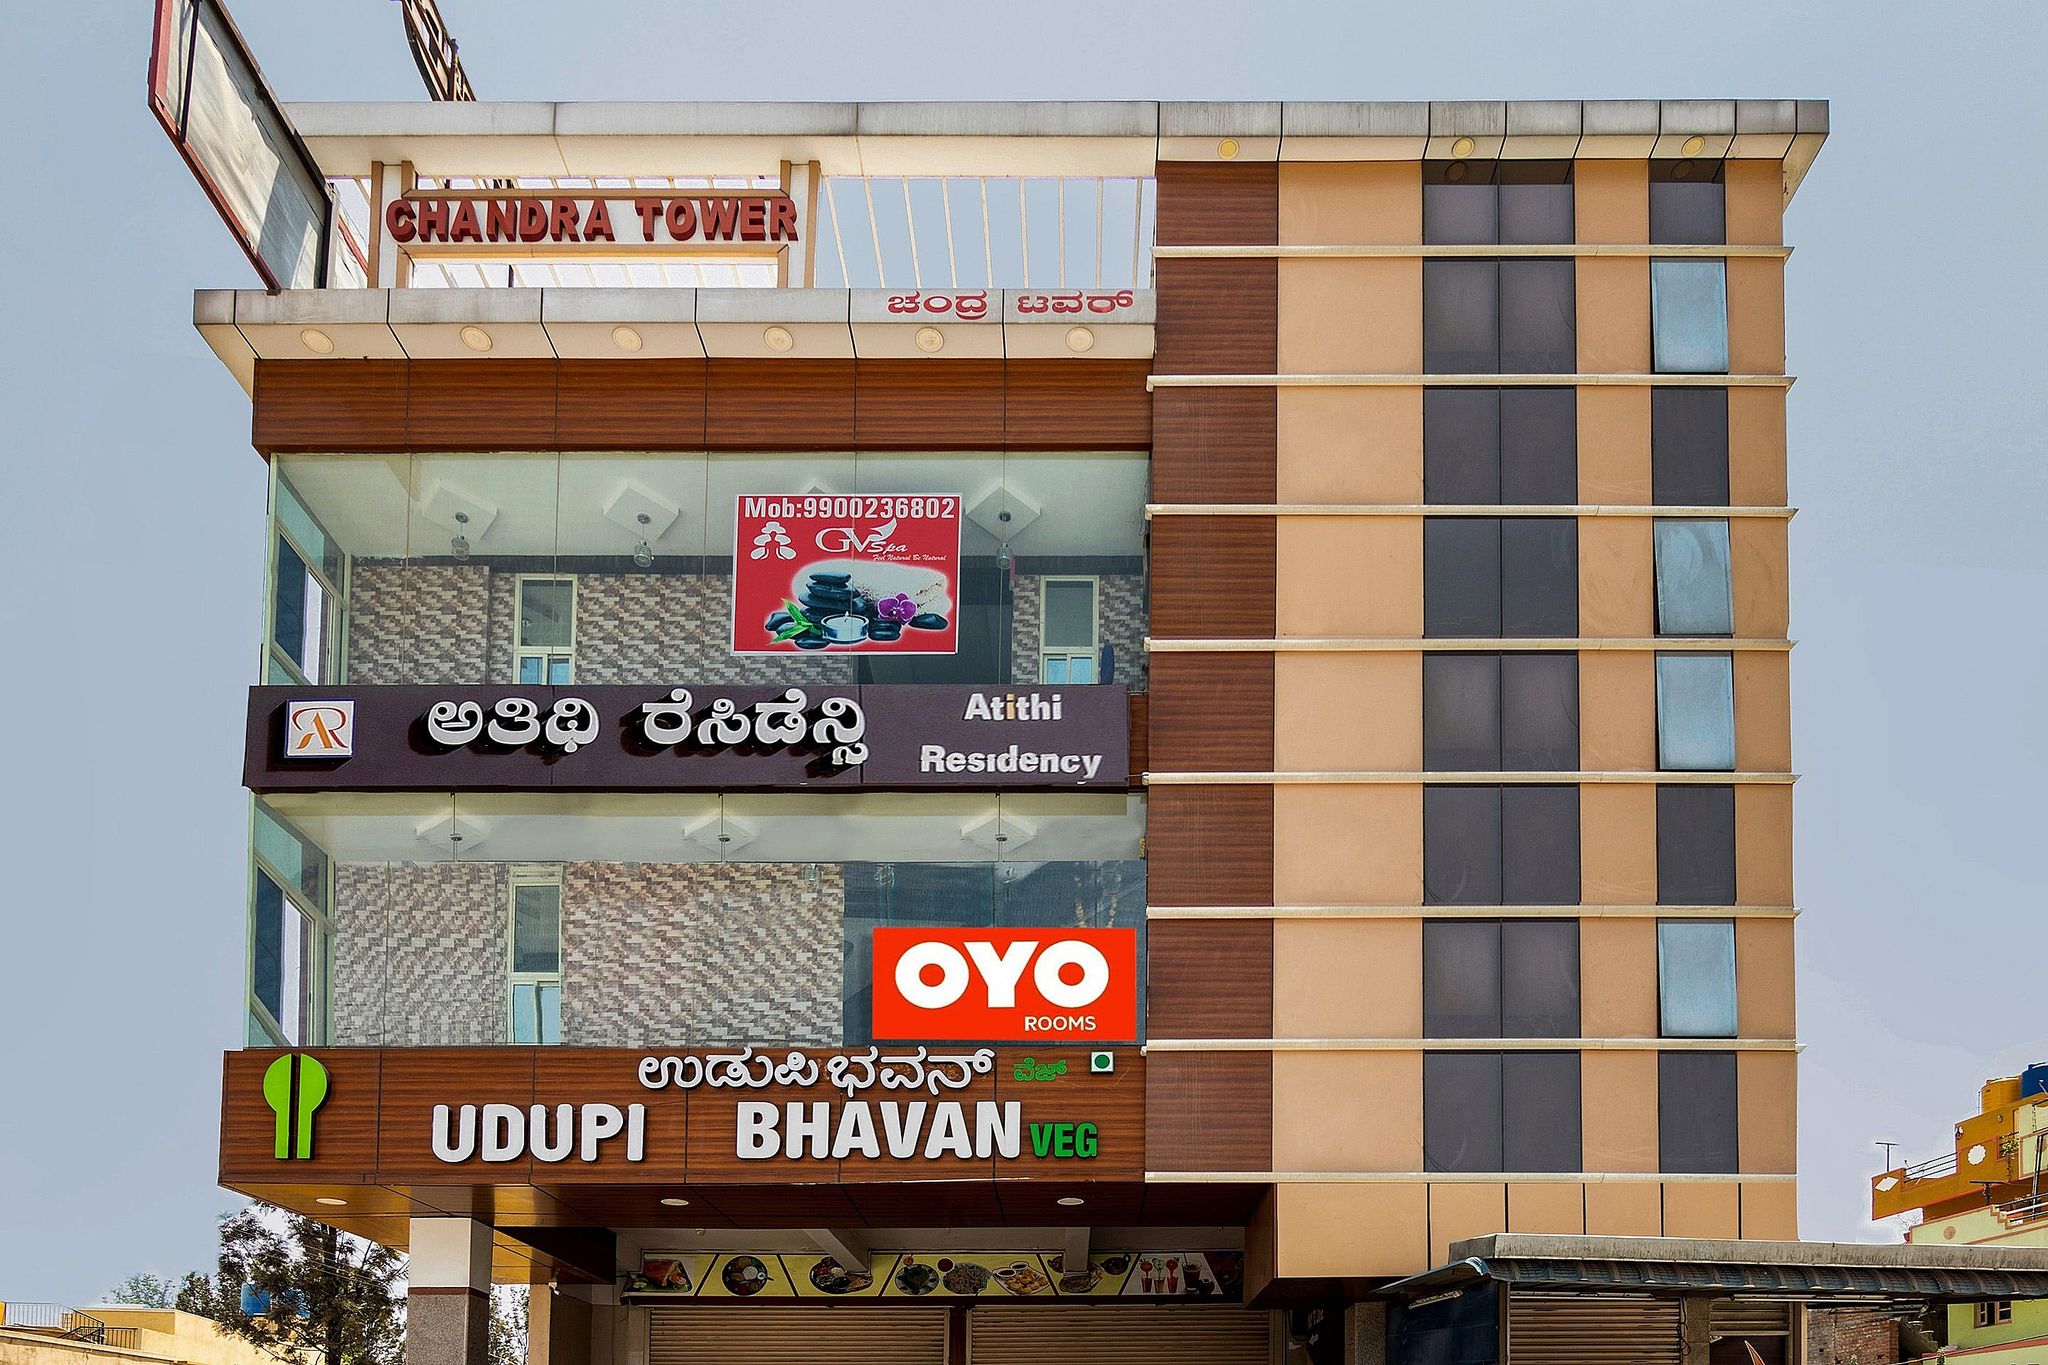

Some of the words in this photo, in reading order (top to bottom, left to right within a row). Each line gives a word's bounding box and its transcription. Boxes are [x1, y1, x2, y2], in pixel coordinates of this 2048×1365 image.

[385, 198, 615, 243] CHANDRA
[634, 198, 799, 242] TOWER
[888, 290, 988, 320] ಚಂದ್ರ
[1017, 290, 1134, 314] ಟವರ್
[745, 497, 955, 519] Mob:9900236802
[427, 697, 600, 753] ಅತಿಥಿ
[964, 693, 1062, 720] Atithi
[920, 745, 1102, 784] Residency
[895, 940, 1110, 1009] OYO
[1024, 1016, 1097, 1031] ROOMS
[432, 1103, 646, 1163] UDUPI
[736, 1101, 1021, 1160] BHAVAN
[1029, 1122, 1098, 1158] VEG
